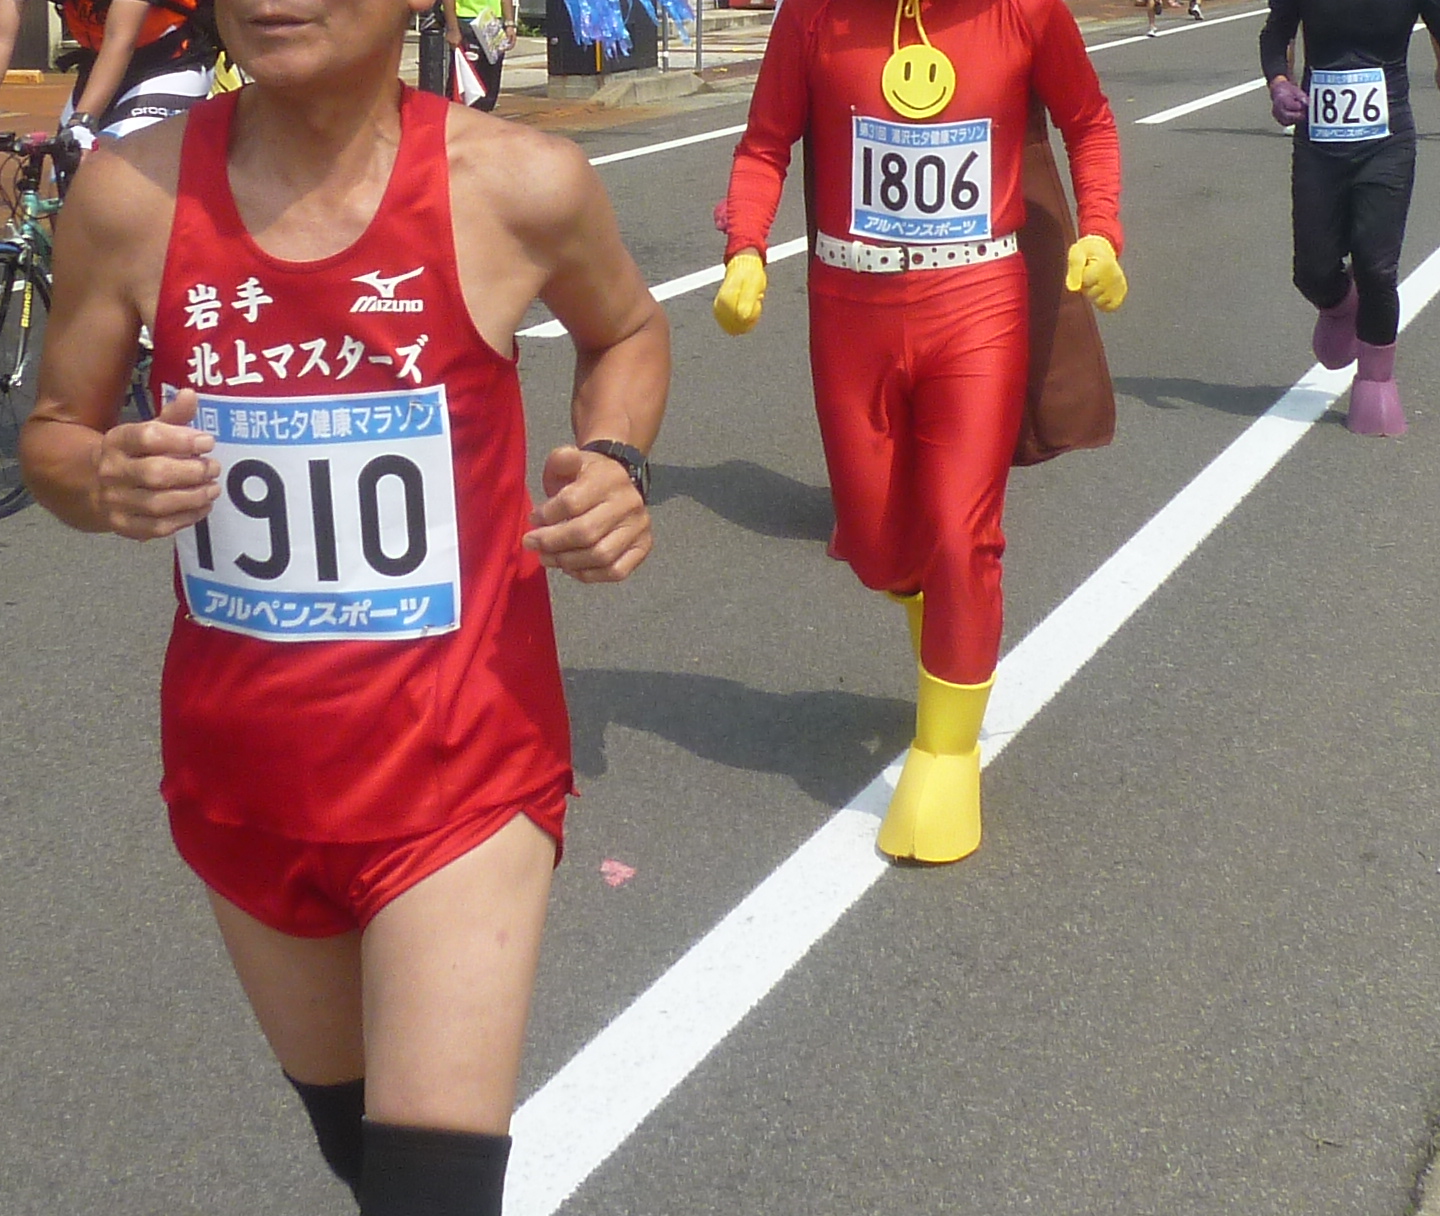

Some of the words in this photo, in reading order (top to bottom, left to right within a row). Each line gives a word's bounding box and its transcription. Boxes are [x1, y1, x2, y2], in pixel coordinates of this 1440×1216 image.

[1314, 87, 1381, 124] 1826
[862, 147, 980, 215] 1806
[864, 215, 977, 236] アルペンスポーツ
[184, 277, 273, 331] 岩手
[186, 334, 430, 388] 北上マスターズ
[230, 404, 436, 442] 湯沢七夕健康マラソン
[204, 589, 431, 628] アルペンスポーツ
